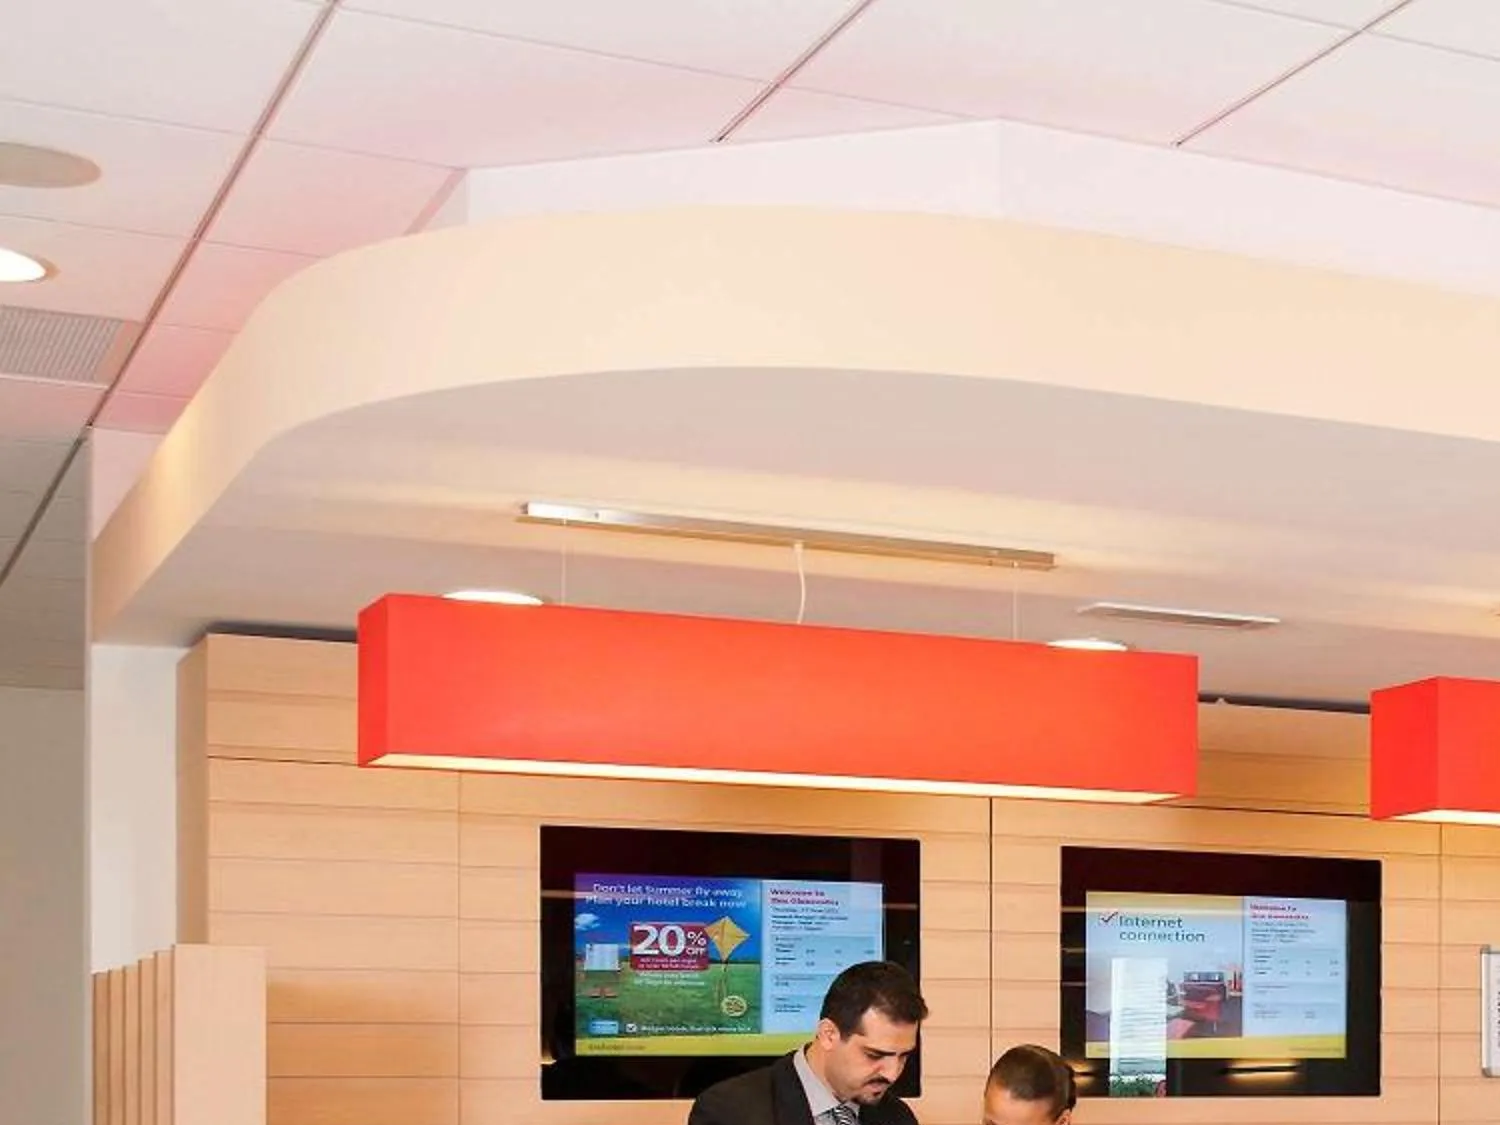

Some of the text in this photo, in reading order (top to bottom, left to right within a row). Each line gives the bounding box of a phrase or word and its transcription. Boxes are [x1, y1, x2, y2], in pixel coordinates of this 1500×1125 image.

[627, 884, 643, 894] let
[616, 897, 643, 907] your
[648, 895, 679, 906] hotel
[682, 897, 716, 908] break
[719, 899, 747, 908] now
[1119, 915, 1183, 929] Internet
[1119, 930, 1205, 943] connection
[686, 947, 707, 957] OFF
